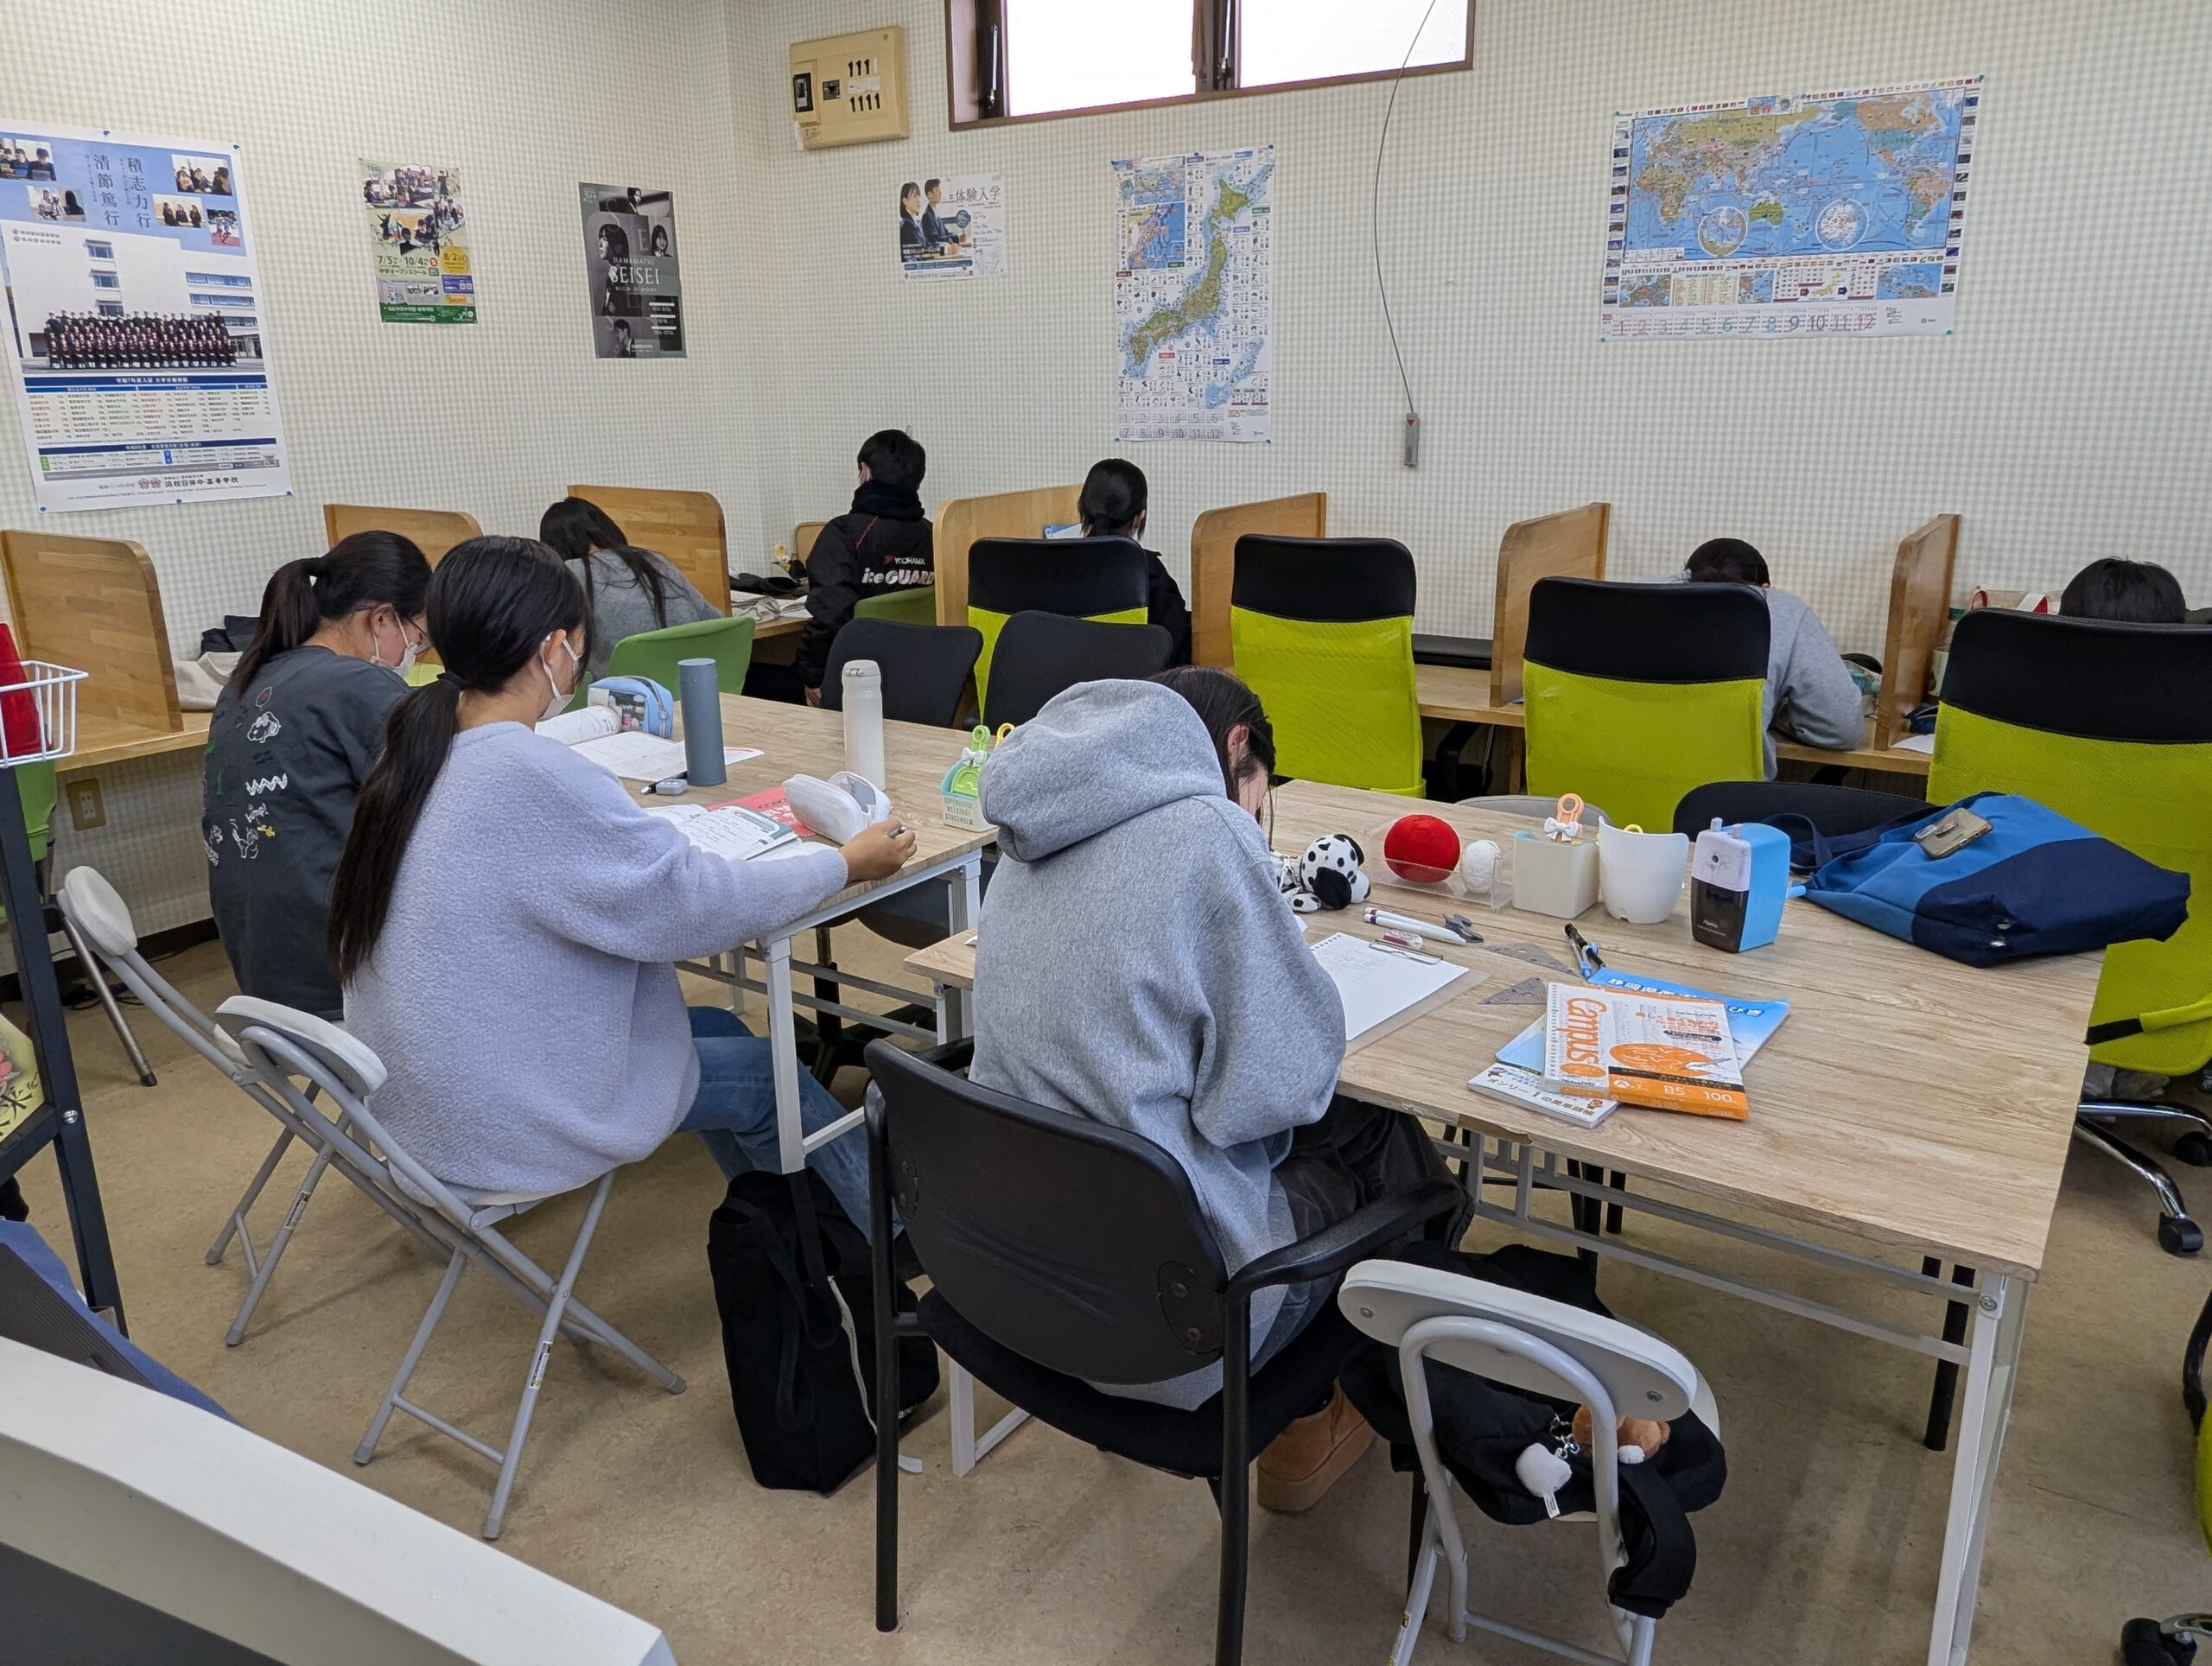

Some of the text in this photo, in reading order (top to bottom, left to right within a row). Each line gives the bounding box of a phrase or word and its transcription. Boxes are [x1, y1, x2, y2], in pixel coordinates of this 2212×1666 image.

[955, 185, 1001, 204] 体験入学
[609, 265, 660, 285] SEISEI
[1789, 315, 1800, 331] 9
[1809, 315, 1825, 332] 10
[893, 556, 925, 566] YOKOHAMA
[1556, 997, 1608, 1065] Campus
[1663, 1085, 1686, 1097] B5
